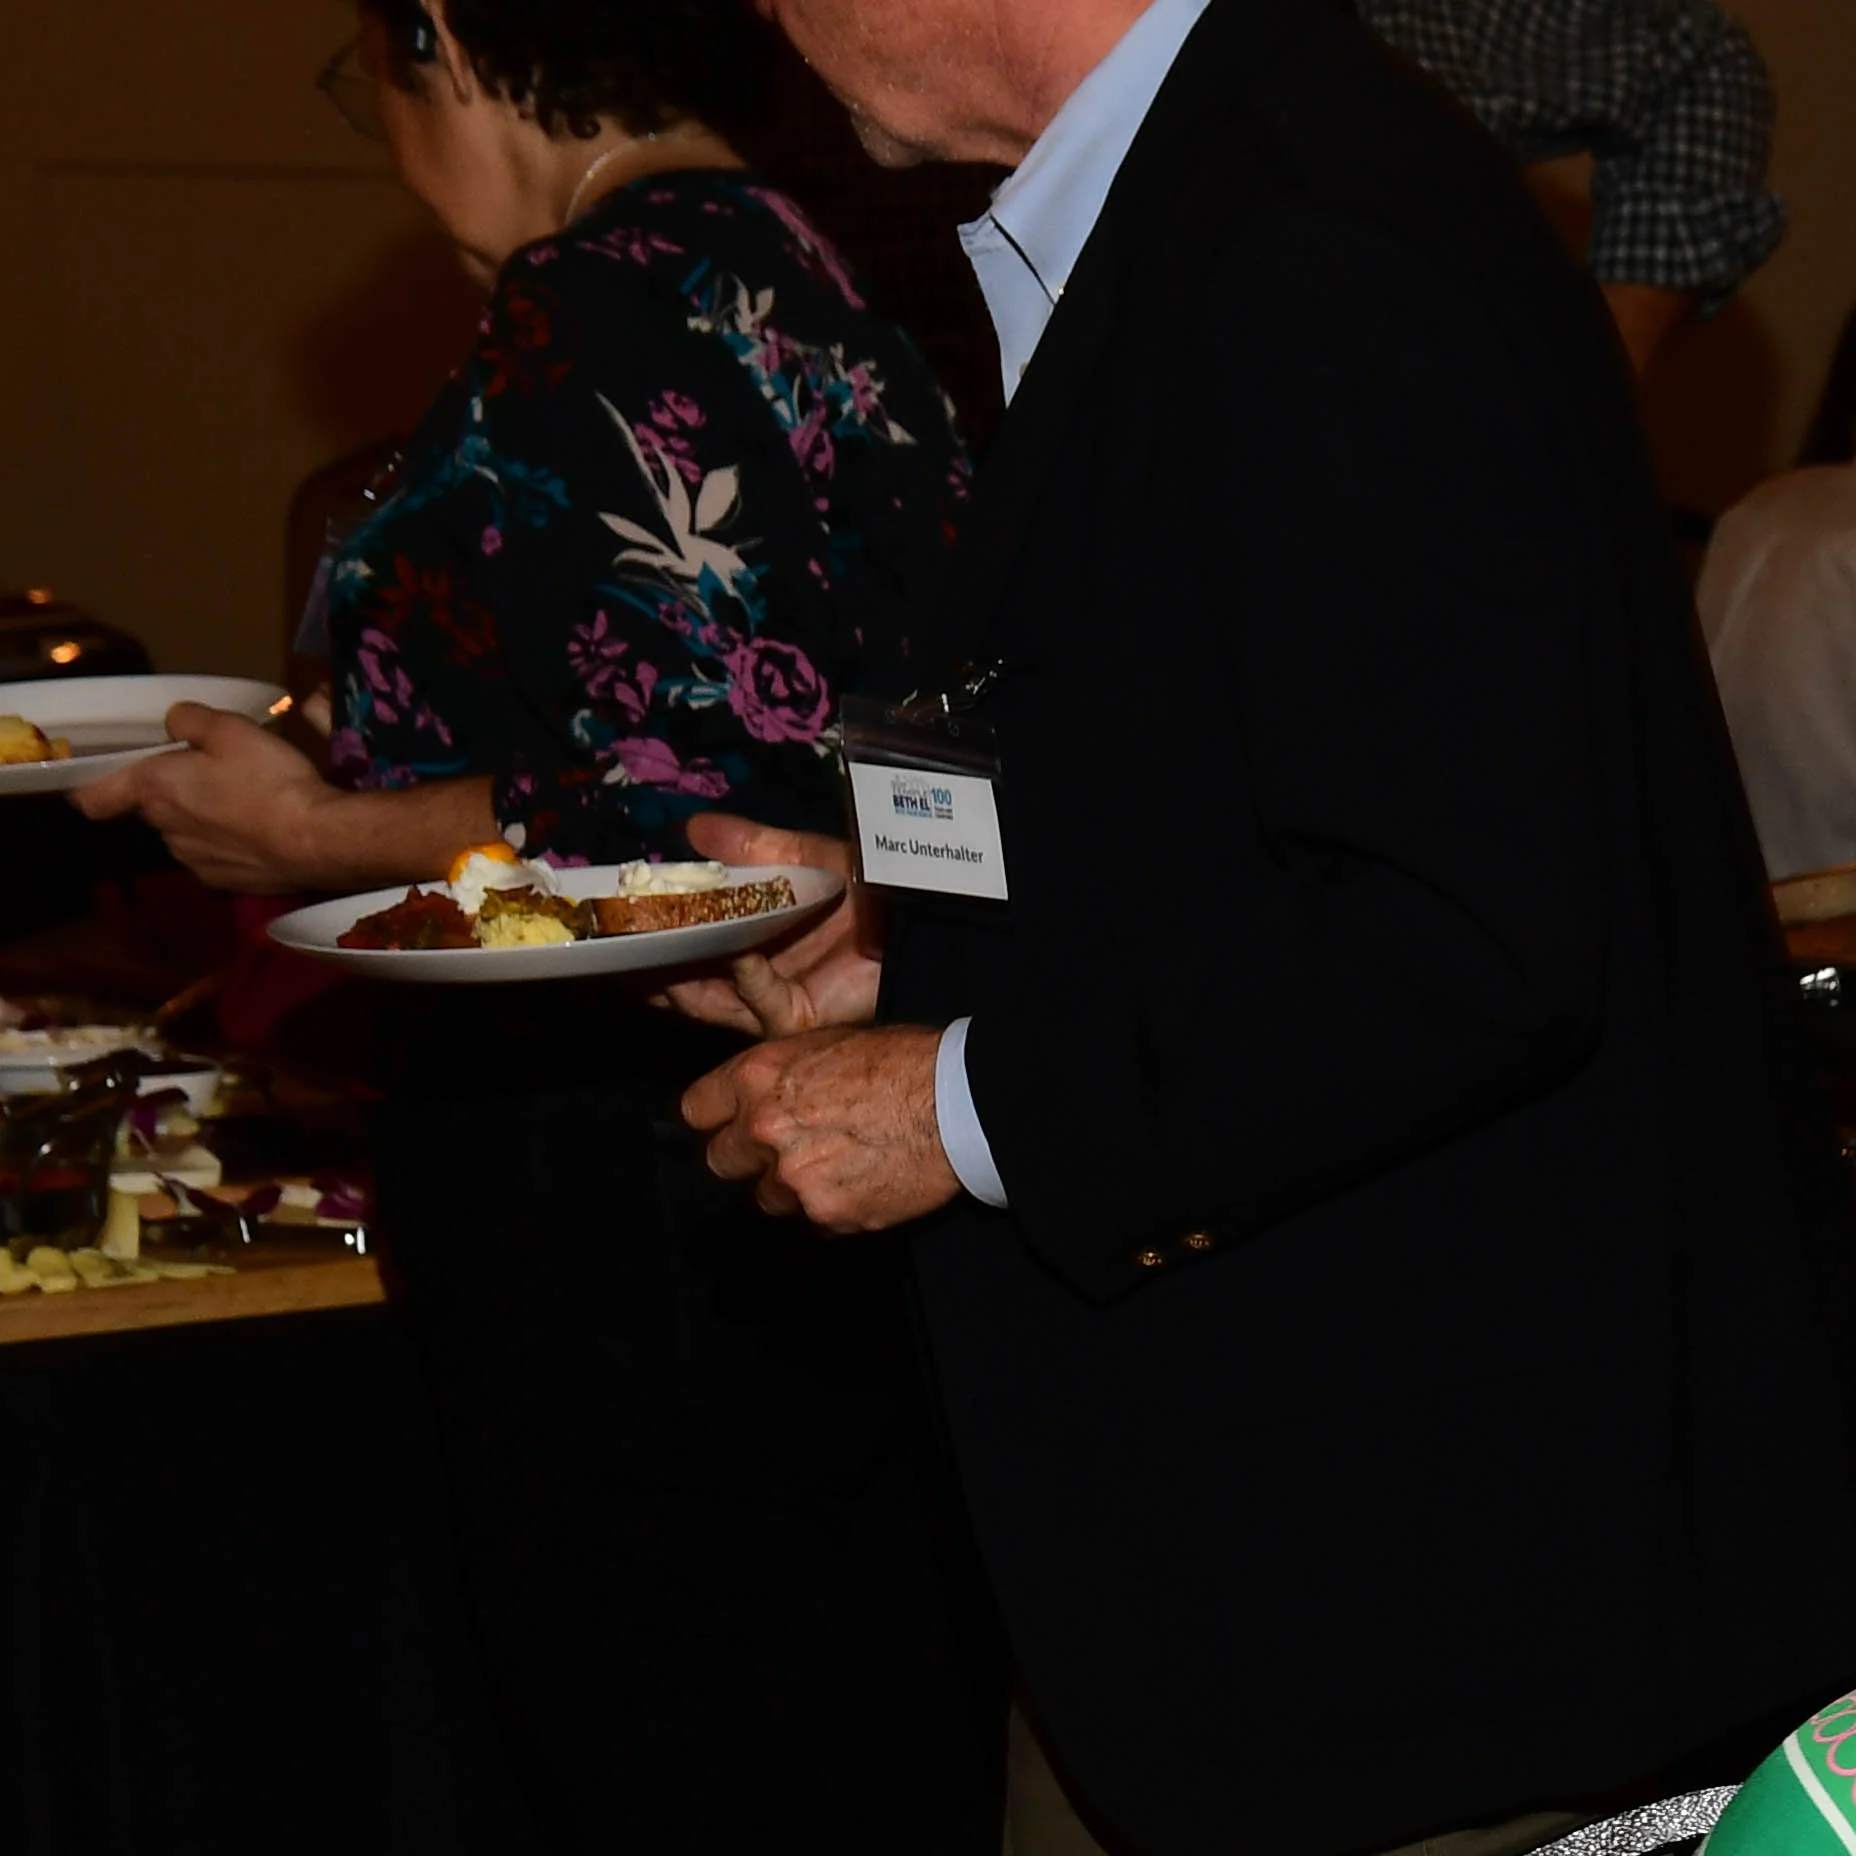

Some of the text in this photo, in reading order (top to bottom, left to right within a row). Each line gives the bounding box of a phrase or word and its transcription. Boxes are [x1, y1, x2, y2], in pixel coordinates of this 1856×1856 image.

[893, 795, 918, 809] BETH
[931, 787, 952, 805] 100
[875, 834, 984, 863] Marc Unterhalter
